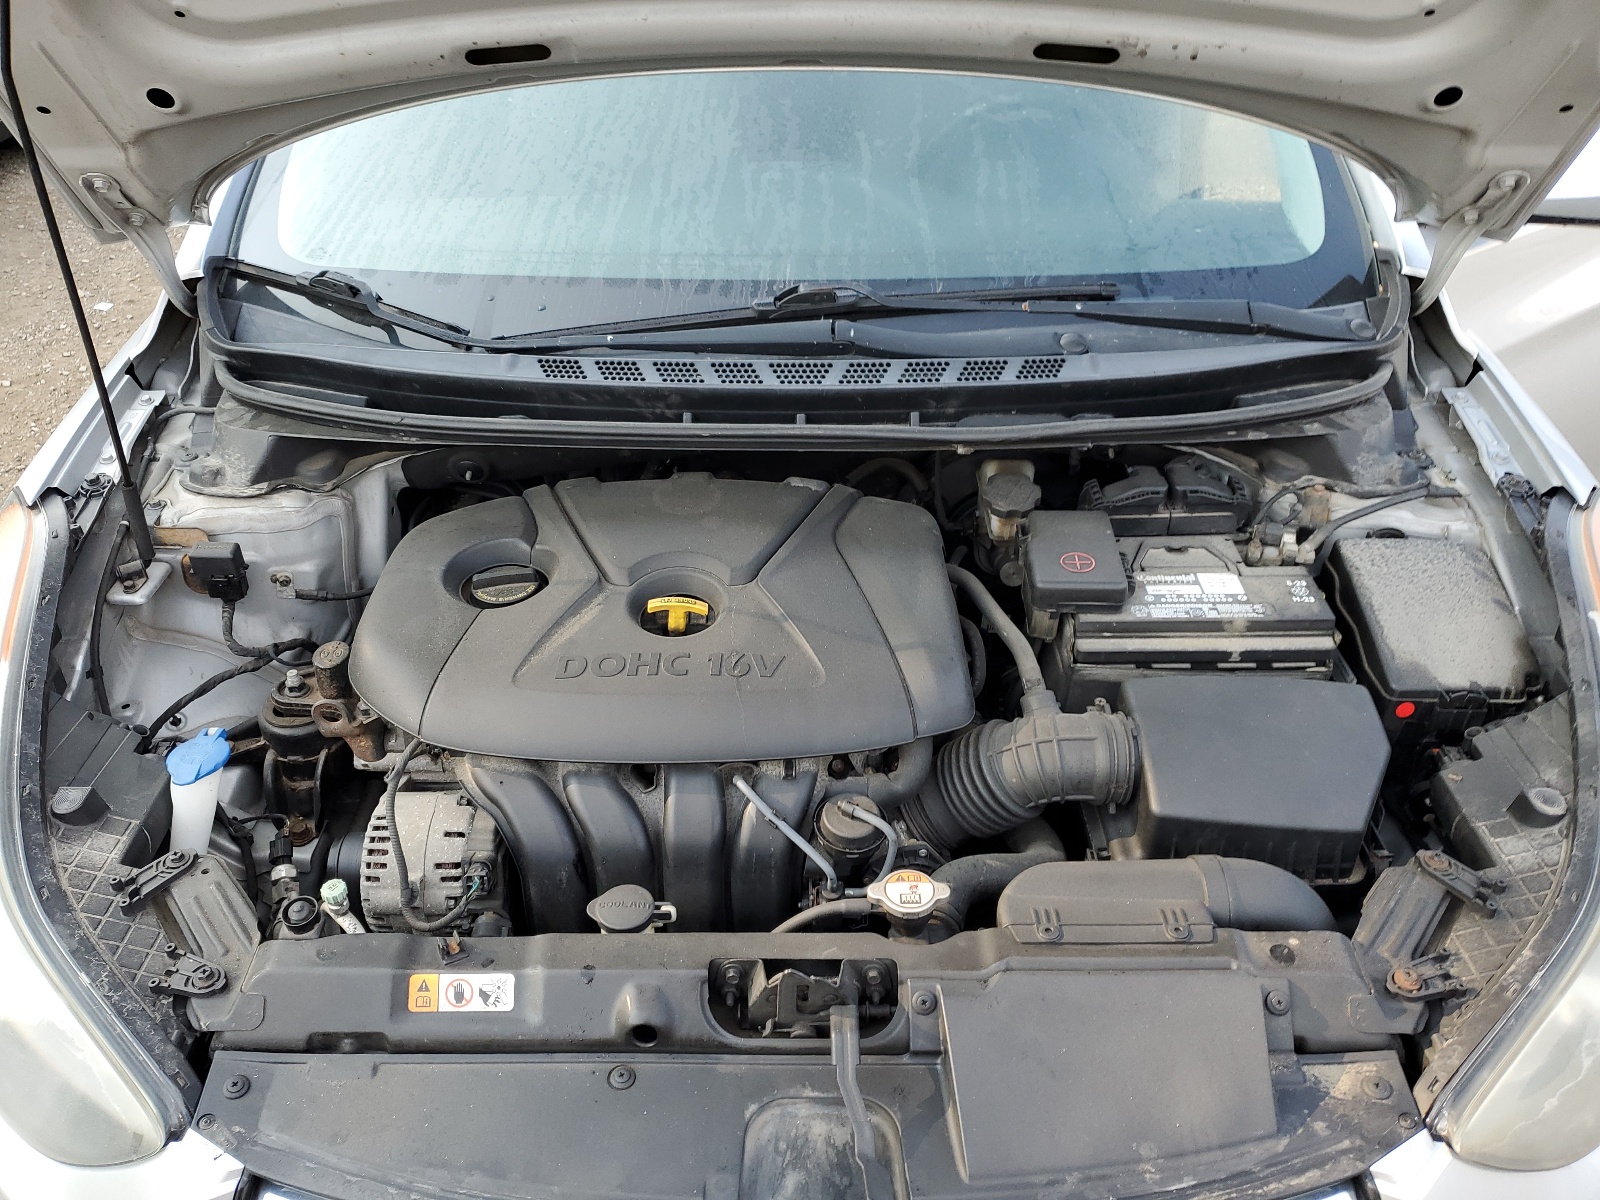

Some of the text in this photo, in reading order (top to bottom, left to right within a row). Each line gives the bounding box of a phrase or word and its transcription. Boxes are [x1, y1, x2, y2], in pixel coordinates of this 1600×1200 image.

[555, 650, 787, 679] DOHC 16V
[599, 900, 652, 910] COOLANT
